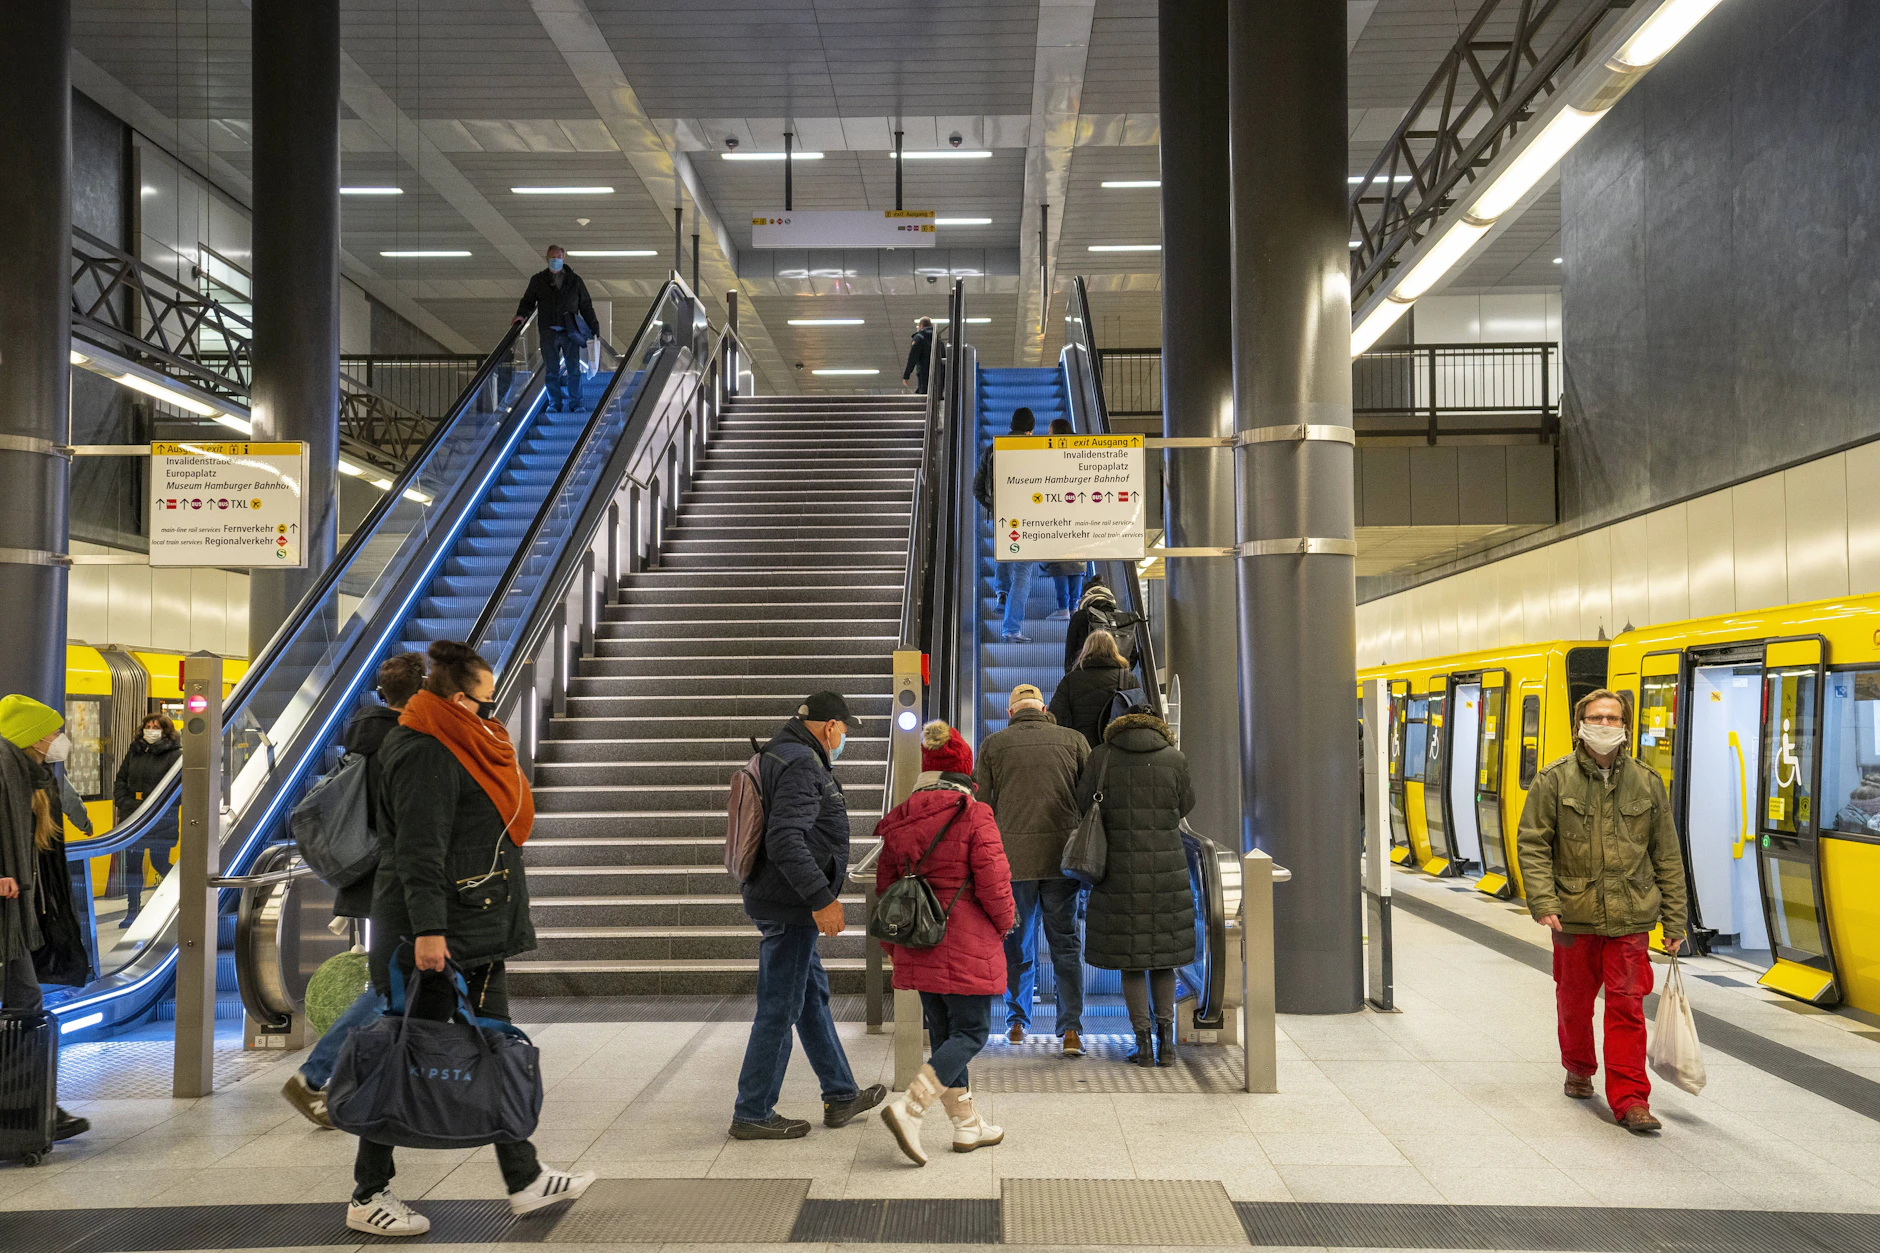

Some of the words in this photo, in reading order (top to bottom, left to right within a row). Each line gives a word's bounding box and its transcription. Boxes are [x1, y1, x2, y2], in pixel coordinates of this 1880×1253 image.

[1073, 438, 1090, 446] exit
[1092, 438, 1128, 448] Ausgang
[167, 444, 204, 455] Ausg
[206, 444, 224, 453] exit
[1063, 449, 1129, 459] Invalidenstraße
[1078, 462, 1129, 472] Europaplatz
[166, 469, 217, 479] Europaplatz
[1006, 476, 1042, 484] Museum
[1044, 475, 1092, 486] Hamburger
[1094, 474, 1130, 483] Bahnhof
[166, 482, 202, 490] Museum
[204, 481, 252, 492] Hamburger
[1045, 493, 1063, 503] TXL
[230, 500, 248, 508] TXL
[1022, 518, 1072, 527] Fernverkehr
[223, 524, 274, 532] Fernverkehr
[1022, 530, 1090, 541] Regionalverkehr
[204, 536, 274, 547] Regionalverkehr
